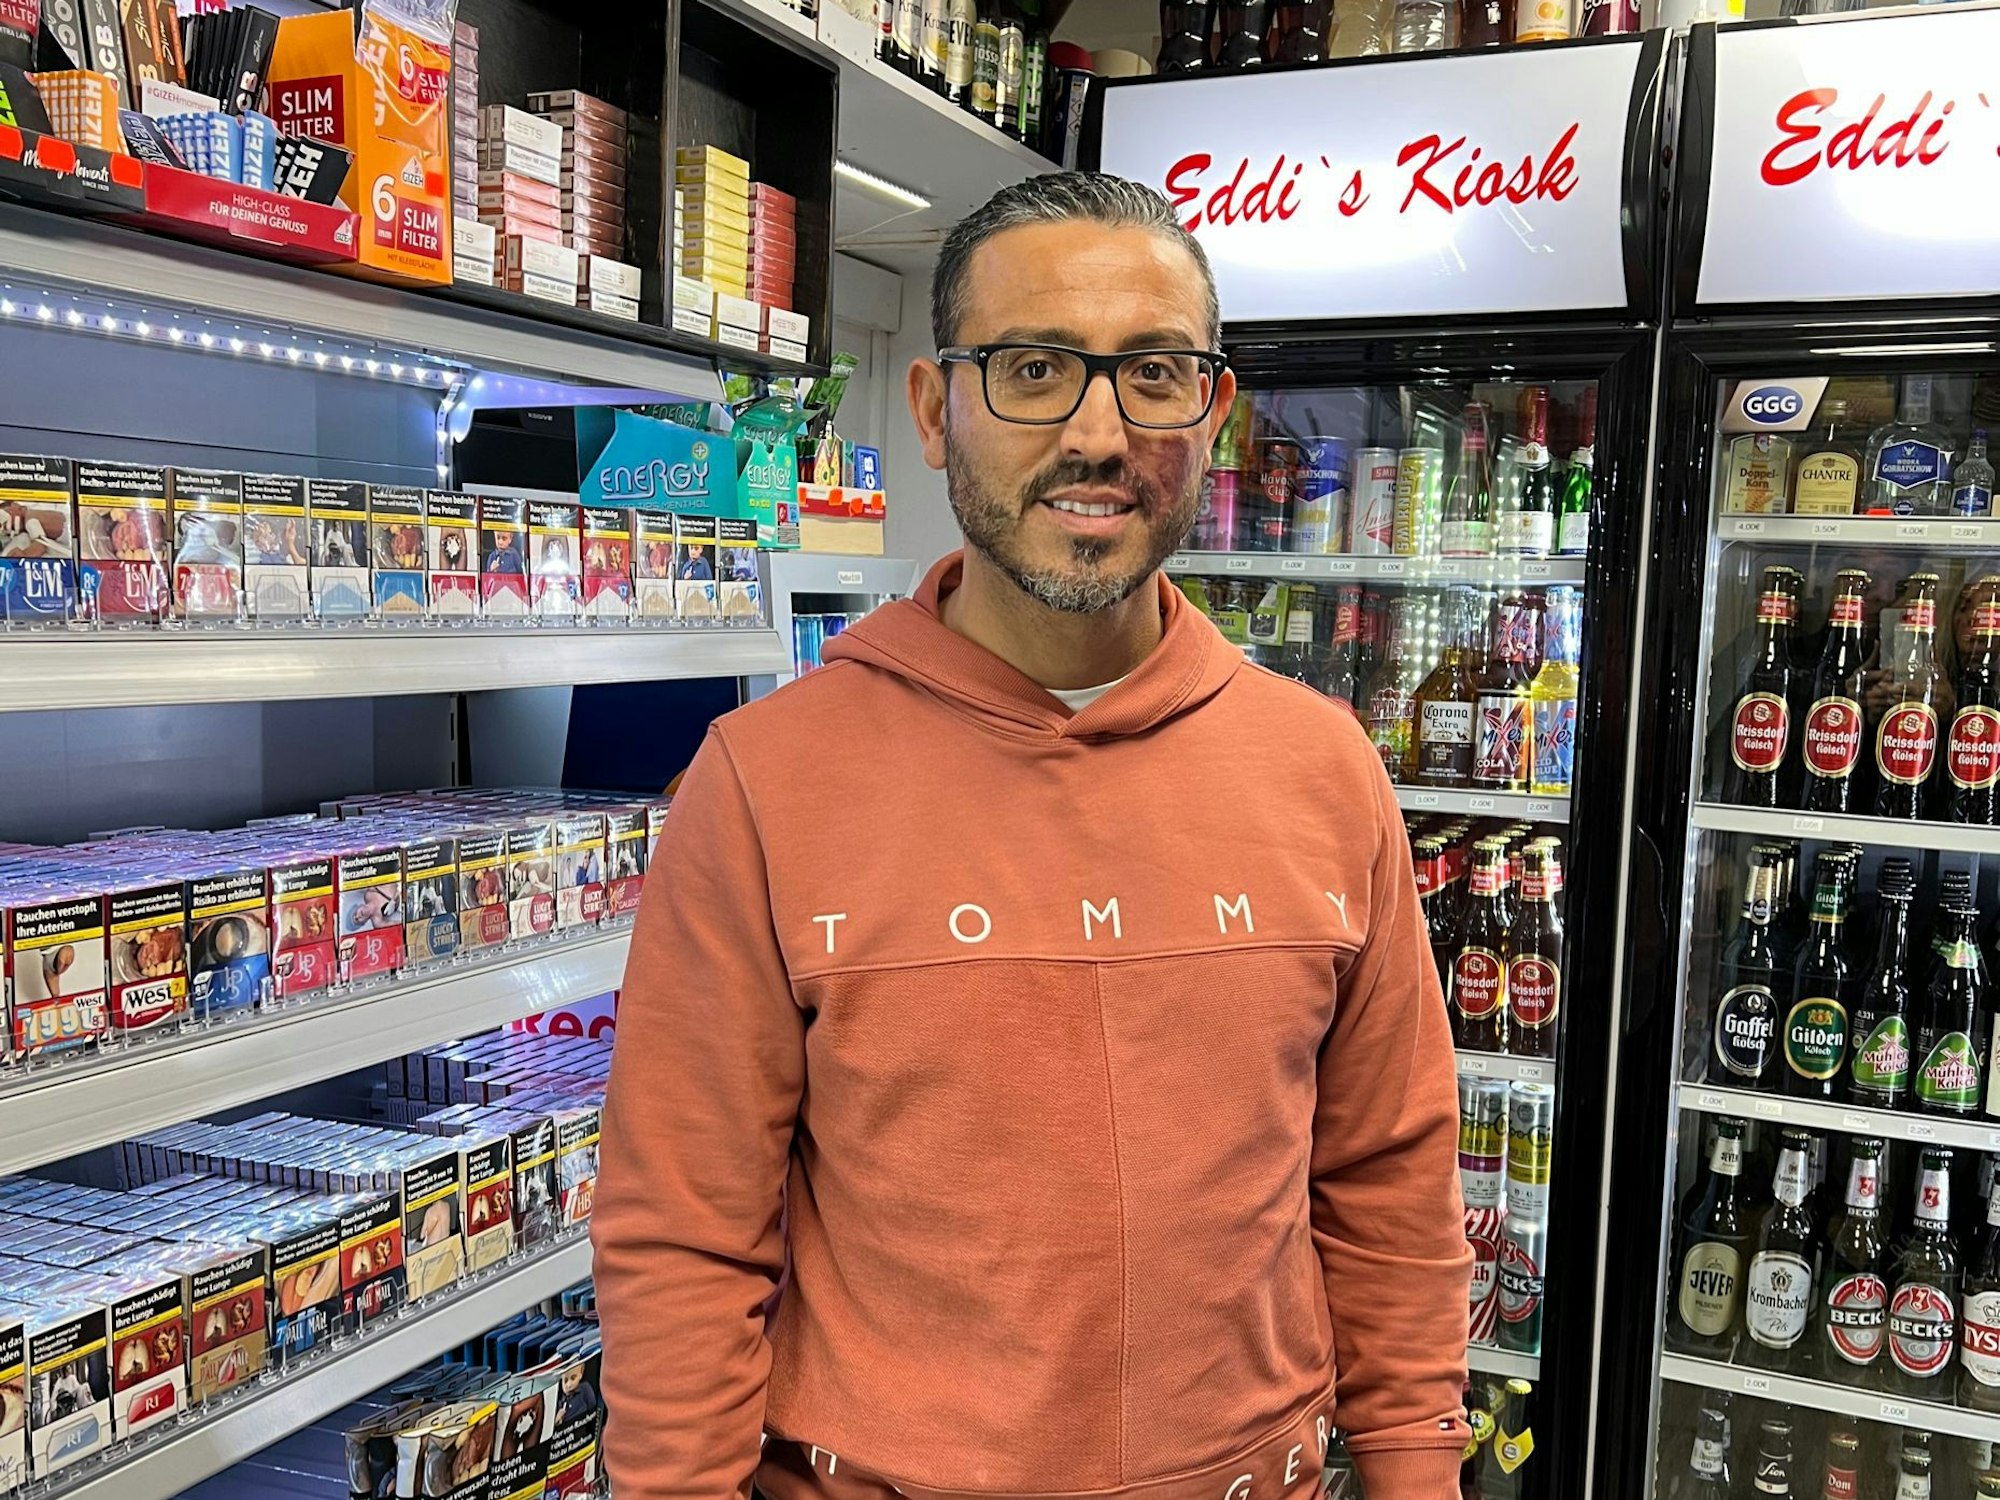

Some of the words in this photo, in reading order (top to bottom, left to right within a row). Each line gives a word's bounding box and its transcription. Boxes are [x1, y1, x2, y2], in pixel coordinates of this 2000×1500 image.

[0, 2, 37, 27] FILTER
[280, 86, 334, 117] SLIM
[84, 79, 102, 148] IZEH
[507, 119, 544, 141] HEETS
[210, 117, 230, 178] IZEH
[1397, 121, 1581, 216] Kiosk
[401, 171, 424, 188] GIZEH
[232, 193, 291, 218] HIGH-CLASS
[370, 173, 396, 223] 6
[209, 201, 229, 217] FÜR
[231, 204, 269, 227] DEINEN
[269, 212, 308, 235] GENUSS!
[402, 206, 439, 233] SLIM
[401, 229, 439, 251] FILTER
[1746, 395, 1797, 414] GGG
[1738, 467, 1780, 481] Doppel-
[1801, 467, 1853, 482] CHANTRÉ
[1881, 463, 1933, 475] GORBATSCHOW
[1267, 485, 1291, 498] Club
[1745, 477, 1770, 490] Korn
[1738, 522, 1761, 533] 4.00€
[1814, 524, 1838, 534] 3.50€
[1901, 526, 1924, 536] 4.00€
[1423, 704, 1469, 720] Corona
[1431, 719, 1459, 730] Extra
[1736, 723, 1785, 739] Reissdorf
[1808, 728, 1859, 745] Reissdorf
[1883, 735, 1936, 751] Reissdorf
[1476, 759, 1505, 768] COLA
[1529, 802, 1551, 812] 2.00€
[340, 857, 369, 869] Rauchen
[368, 851, 400, 865] verursacht
[302, 865, 329, 878] schädigt
[192, 882, 226, 895] Rauchen
[226, 878, 251, 893] erhöht
[250, 875, 264, 887] das
[288, 879, 309, 891] Lunge
[112, 899, 137, 910] Rauchen
[192, 893, 218, 908] Risiko
[217, 893, 227, 905] zu
[227, 887, 262, 902] erblinden
[584, 890, 603, 903] LUCKY
[1815, 890, 1844, 905] Gilden
[15, 909, 56, 926] Rauchen
[56, 900, 98, 918] verstopft
[533, 901, 553, 914] LUCKY
[583, 900, 605, 915] STRIKE
[485, 913, 505, 925] LUCKY
[811, 889, 1351, 954] TOMMY
[15, 923, 37, 938] Ihre
[37, 919, 76, 937] Arterien
[433, 922, 455, 937] LUCKY
[1455, 973, 1499, 991] Reissdorf
[1510, 980, 1555, 998] Reissdorf
[75, 995, 103, 1009] West
[126, 985, 174, 1009] West
[1724, 1013, 1775, 1042] Gaffel
[1791, 1025, 1845, 1048] Gilden
[1732, 1033, 1767, 1051] Kölsch
[1803, 1044, 1832, 1057] Kölsch
[1925, 1065, 1974, 1079] Mühlen
[1936, 1076, 1978, 1089] Kölsch
[406, 1169, 429, 1183] Rauchen
[480, 1167, 495, 1180] Lunge
[576, 1191, 593, 1211] HB
[340, 1209, 367, 1227] Rauchen
[366, 1201, 391, 1217] schädigt
[340, 1226, 354, 1238] Ihre
[353, 1220, 373, 1234] Lunge
[193, 1269, 224, 1287] Rauchen
[224, 1257, 253, 1277] schädigt
[193, 1285, 209, 1299] Ihre
[208, 1277, 232, 1295] Lunge
[1688, 1268, 1735, 1298] JEVER
[114, 1300, 146, 1318] Rauchen
[145, 1285, 177, 1308] schädigt
[374, 1283, 392, 1303] MALL
[1749, 1289, 1808, 1311] Krombacher
[115, 1315, 131, 1329] Ihre
[130, 1307, 155, 1325] Lunge
[32, 1333, 55, 1348] Rauchen
[55, 1323, 82, 1342] verursacht
[286, 1321, 304, 1344] PALL
[308, 1311, 328, 1333] MALL
[1890, 1317, 1954, 1338] BECK'S
[8, 1335, 24, 1351] das
[68, 1332, 79, 1343] und
[1745, 1378, 1768, 1389] 2.00€
[1883, 1406, 1907, 1417] 2.00€
[565, 1433, 576, 1445] oft
[569, 1433, 593, 1452] Rauchen
[517, 1460, 537, 1476] Ihre
[1758, 1461, 1786, 1479] Sion
[452, 1473, 491, 1500] verursacht
[1827, 1475, 1852, 1492] Dom
